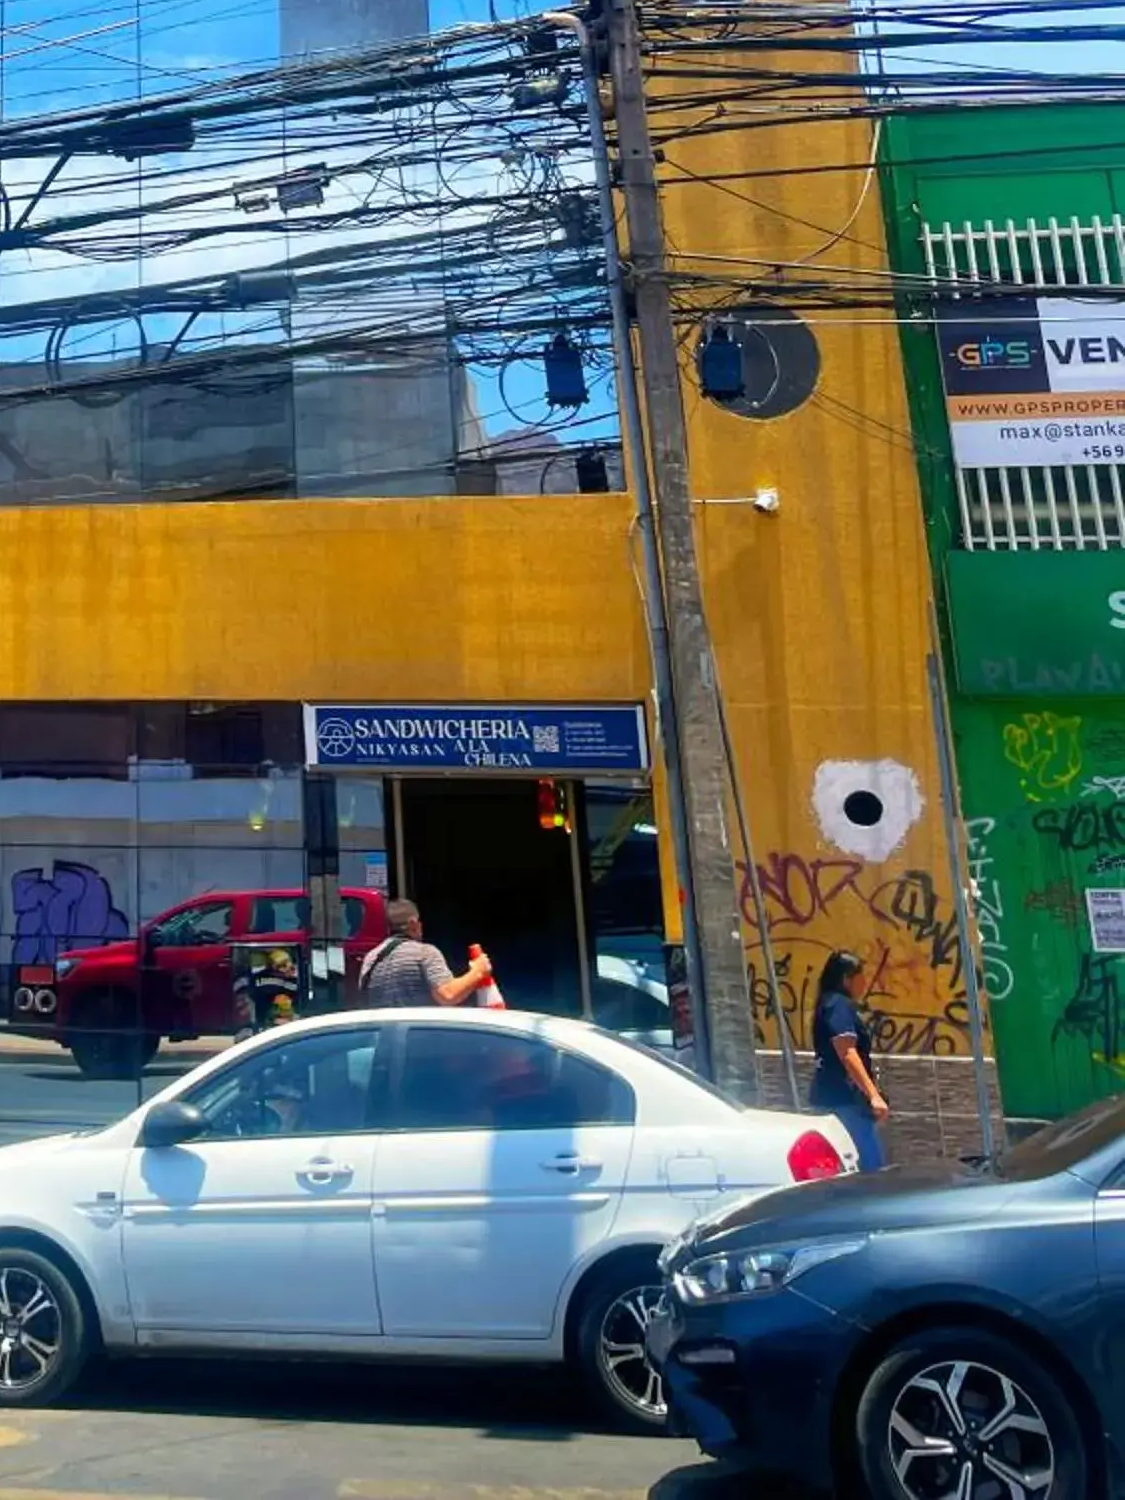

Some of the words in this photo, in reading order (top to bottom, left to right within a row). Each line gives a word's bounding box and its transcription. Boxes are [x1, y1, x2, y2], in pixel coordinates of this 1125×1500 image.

[955, 340, 1030, 366] GPS
[354, 717, 531, 740] SANDWICHERIA
[356, 742, 446, 757] NIKYASAN
